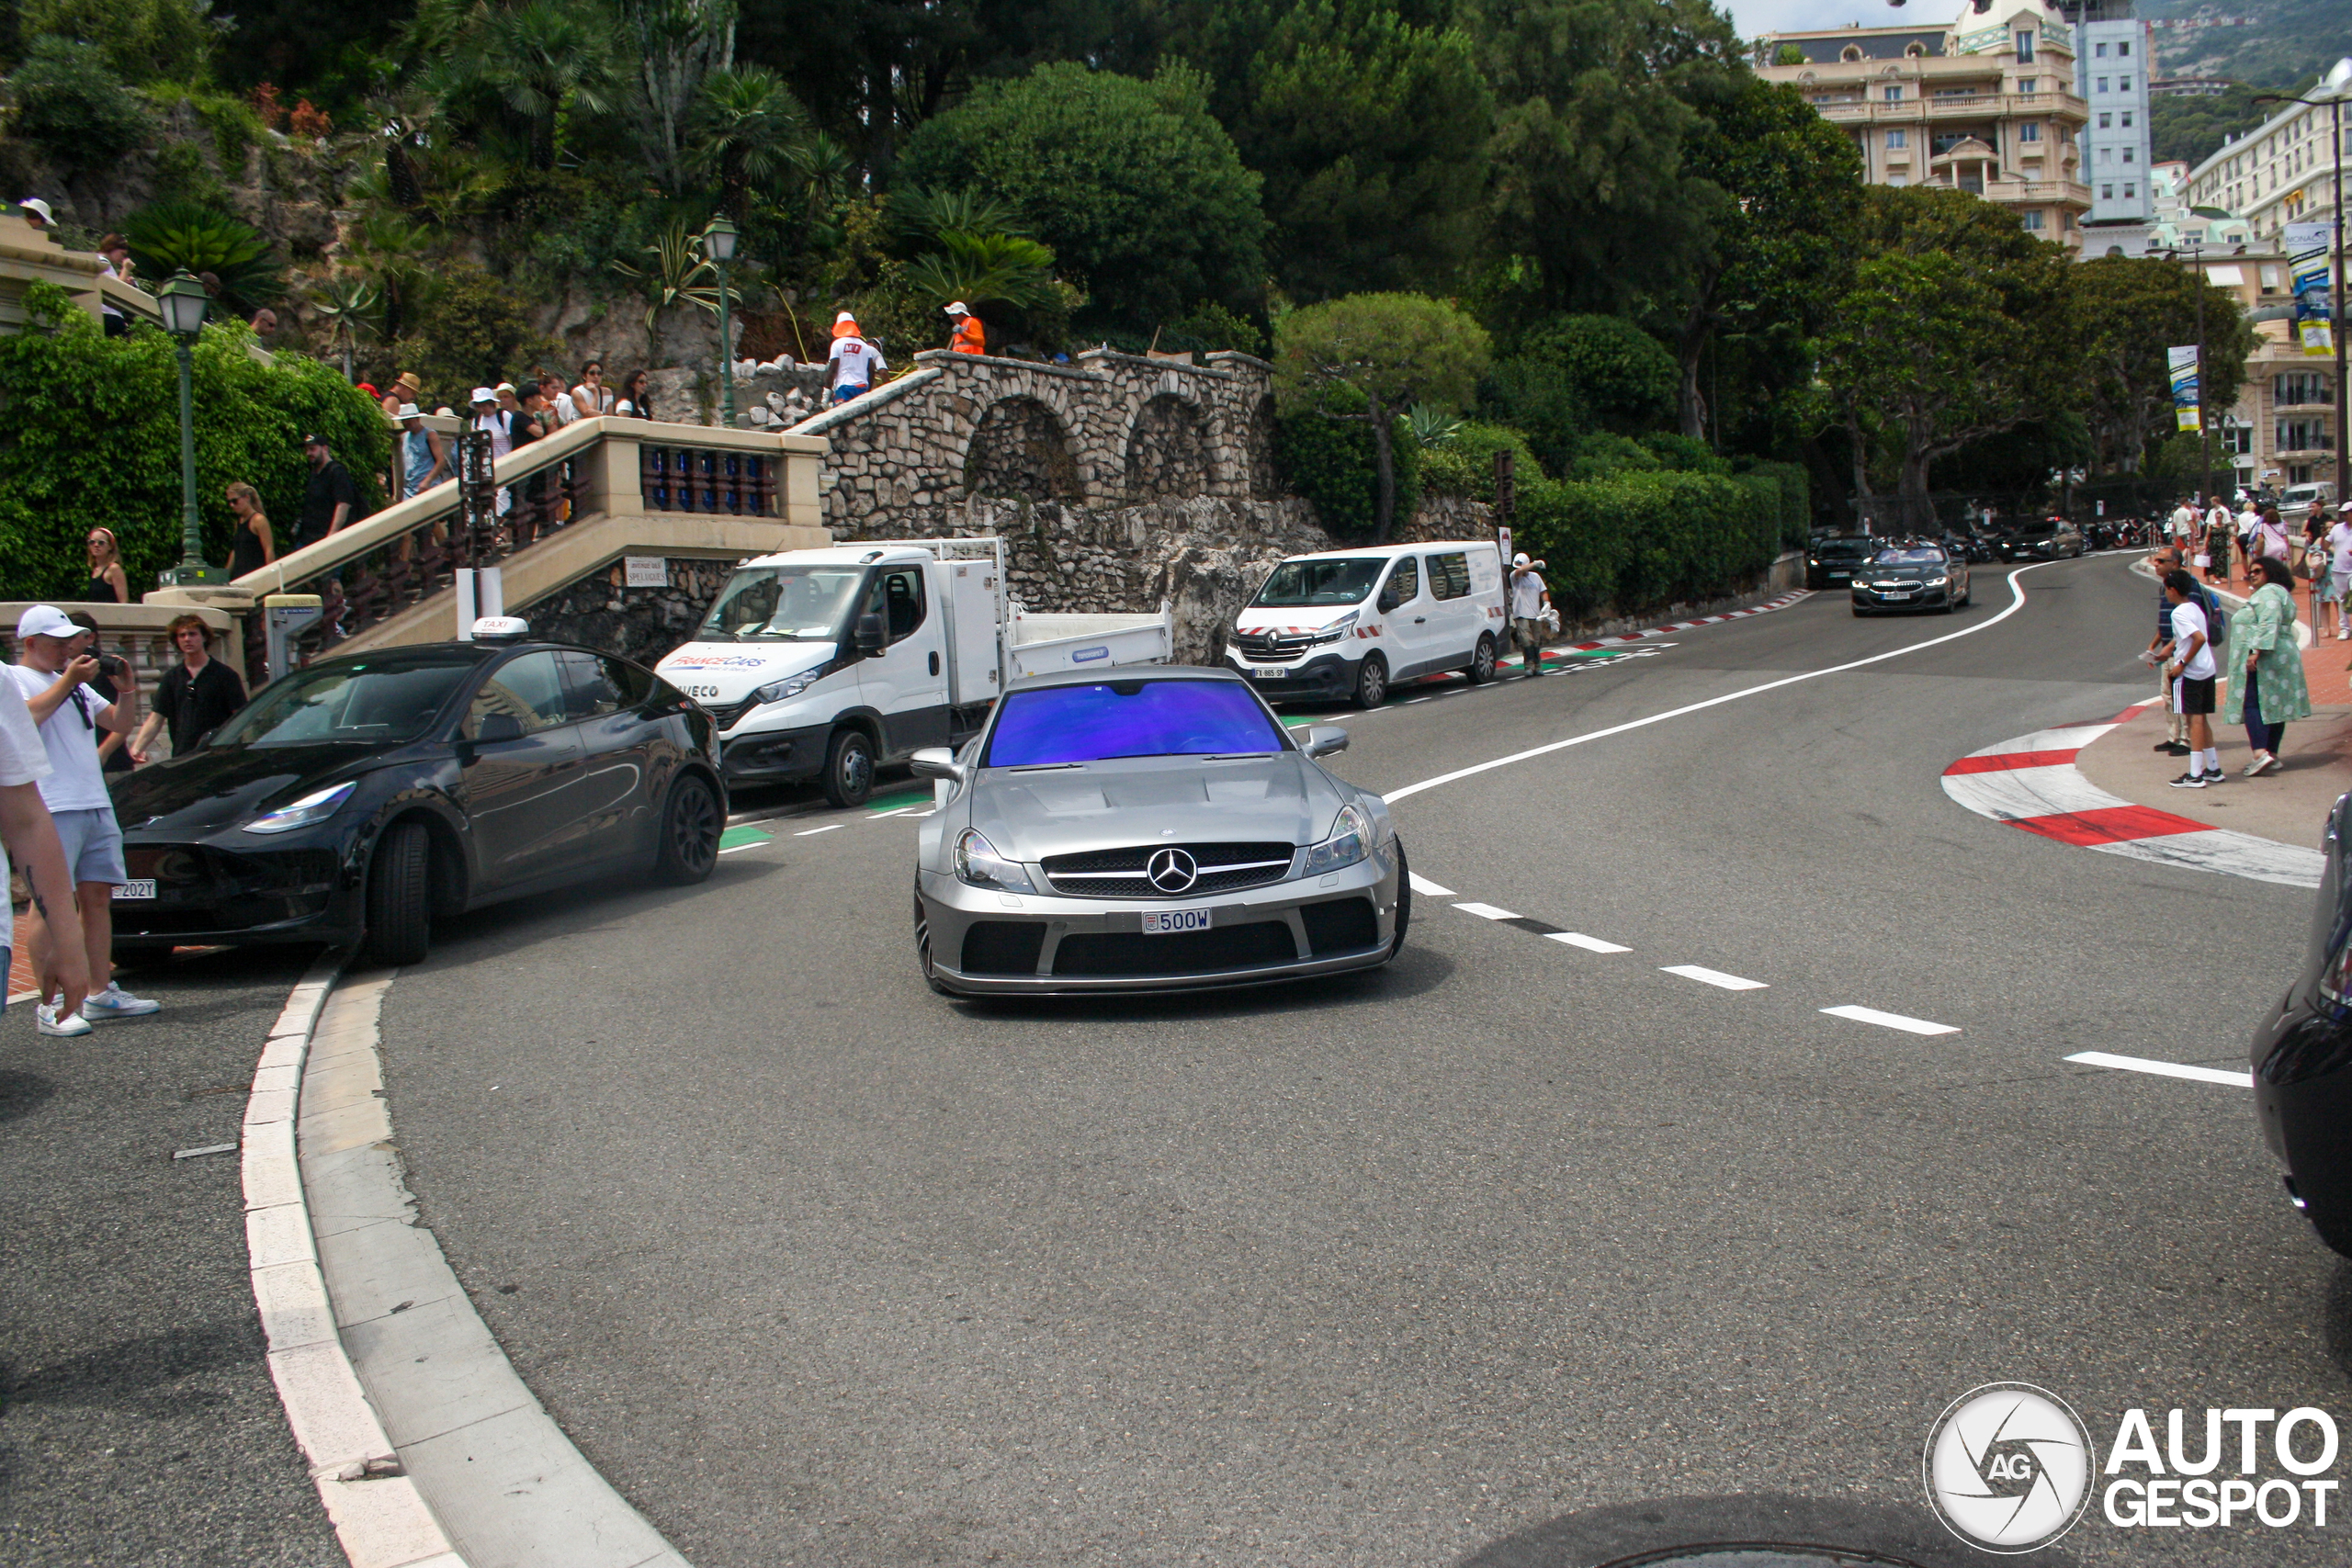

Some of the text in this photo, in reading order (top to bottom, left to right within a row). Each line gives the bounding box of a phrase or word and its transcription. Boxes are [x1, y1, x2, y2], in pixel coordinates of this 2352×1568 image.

[628, 572, 666, 581] SPELUGUES
[483, 620, 509, 628] TAXI
[122, 882, 153, 897] 202Y
[1160, 910, 1207, 931] 500W
